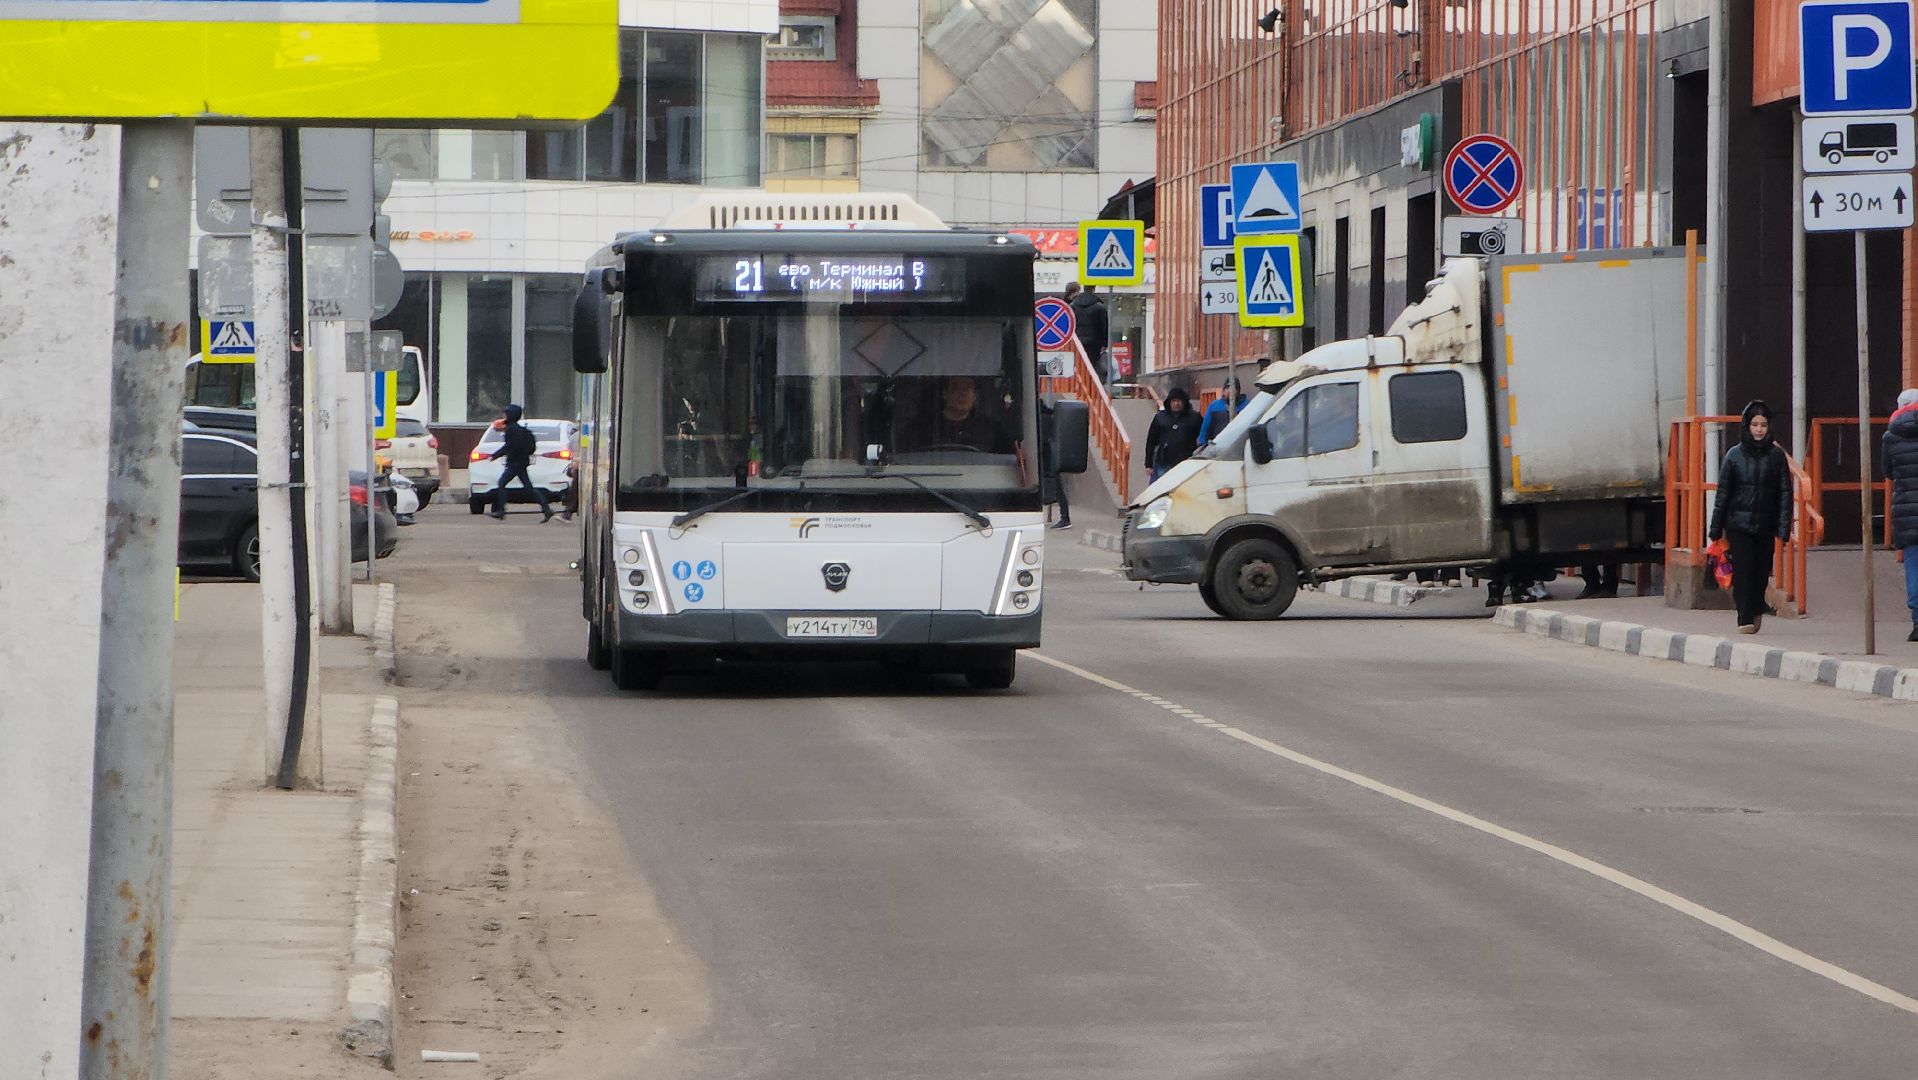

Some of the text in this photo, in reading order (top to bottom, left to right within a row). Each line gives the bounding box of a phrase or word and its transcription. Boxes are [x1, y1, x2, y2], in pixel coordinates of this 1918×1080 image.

[1832, 14, 1893, 101] P
[735, 260, 763, 291] 21
[820, 261, 904, 277] Терминал
[809, 277, 842, 290] м/к
[851, 276, 904, 290] Южный
[1219, 292, 1239, 304] 30
